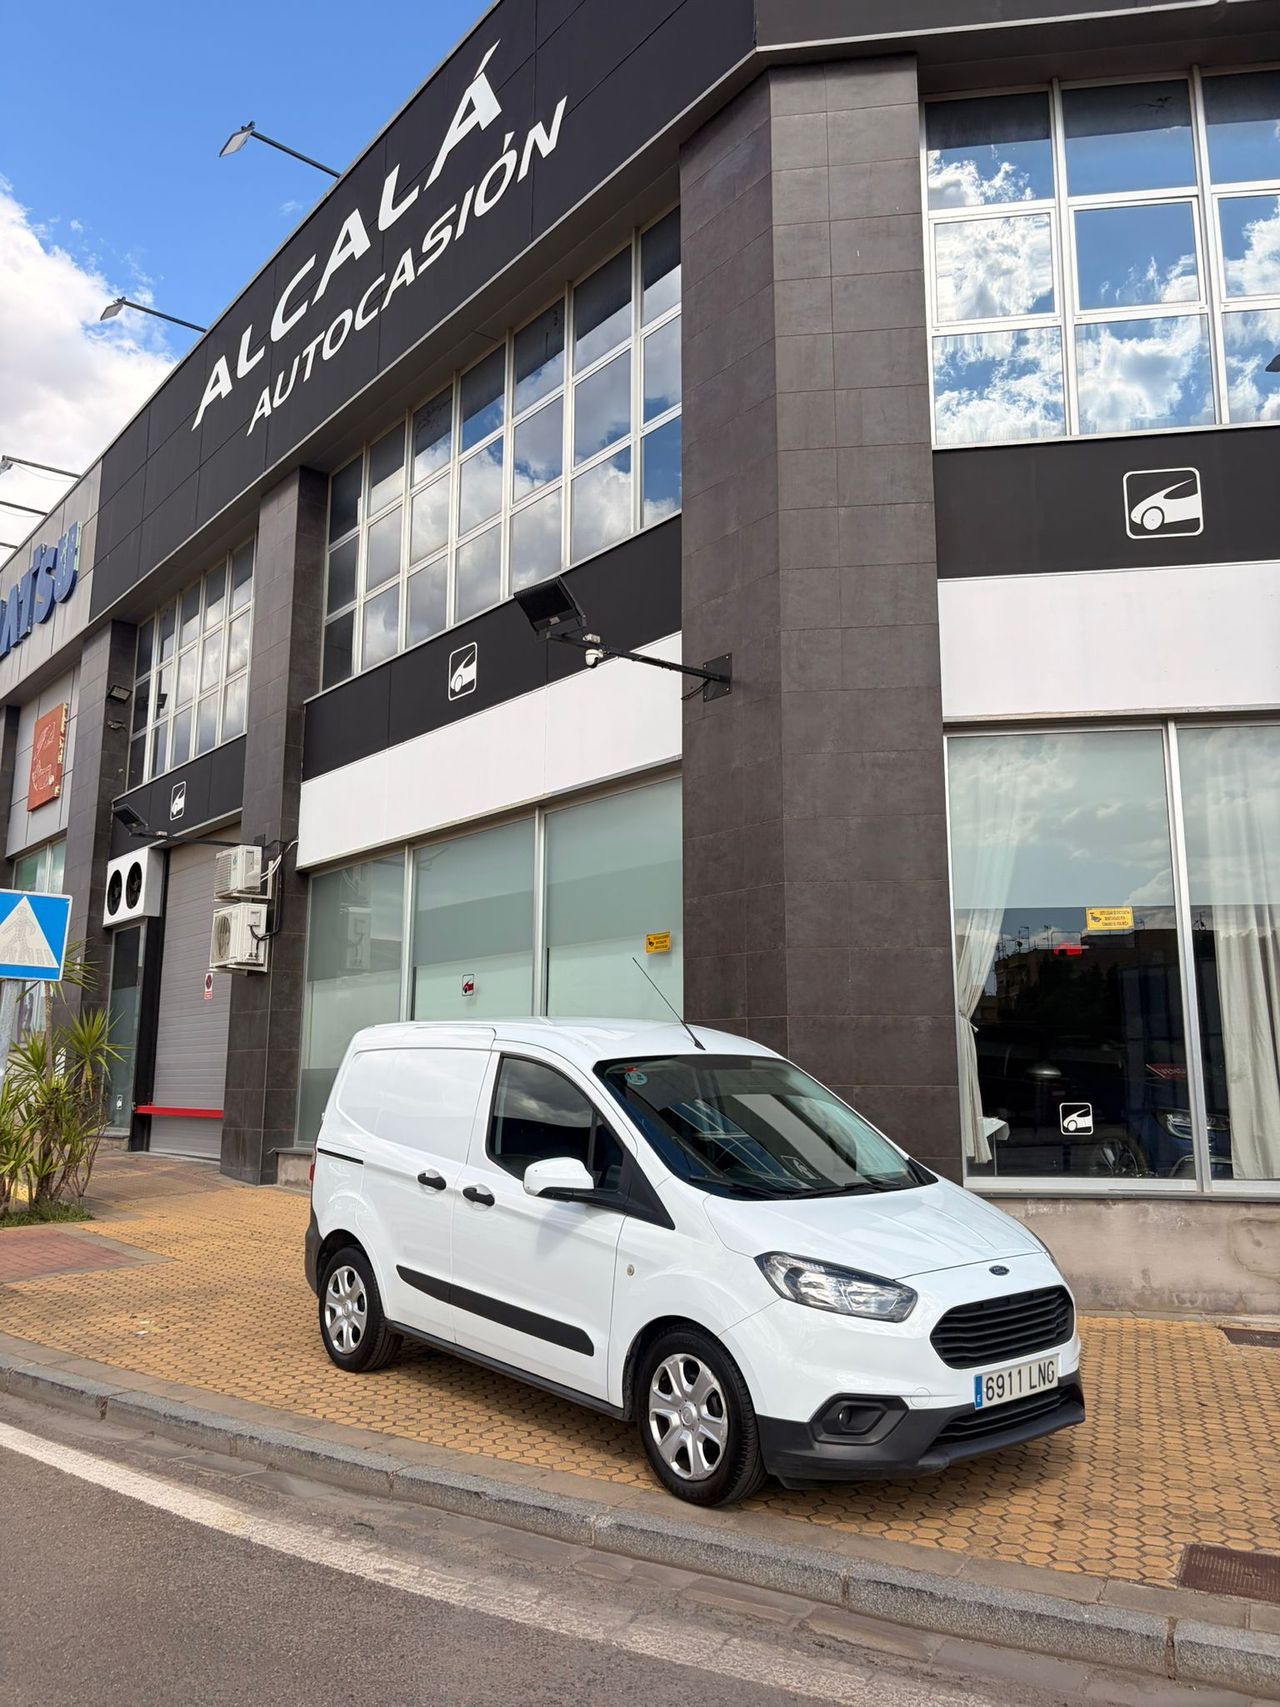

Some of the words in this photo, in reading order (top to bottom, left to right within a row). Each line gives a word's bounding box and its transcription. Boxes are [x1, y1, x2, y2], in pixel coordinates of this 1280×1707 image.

[192, 38, 502, 431] ALCALÁ
[246, 96, 567, 436] AUTOCASIÓN
[985, 1368, 1022, 1401] 6911
[1029, 1360, 1055, 1390] LNG
